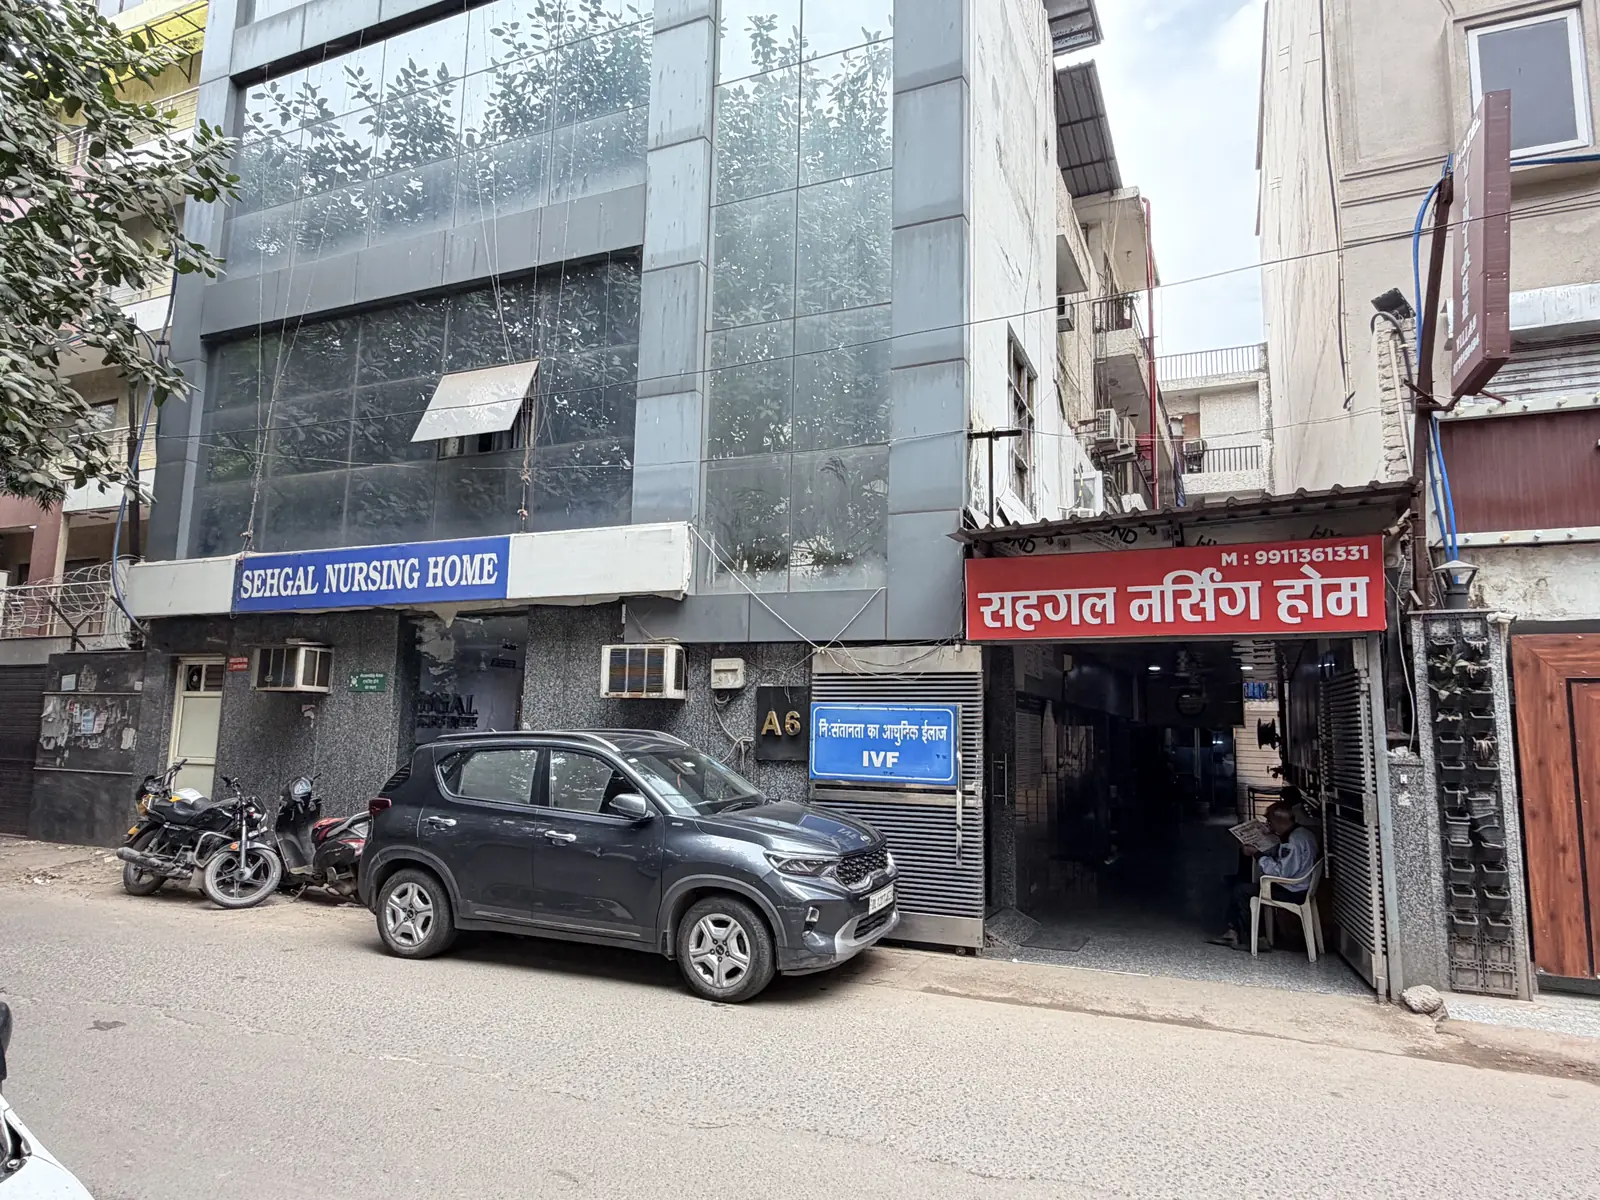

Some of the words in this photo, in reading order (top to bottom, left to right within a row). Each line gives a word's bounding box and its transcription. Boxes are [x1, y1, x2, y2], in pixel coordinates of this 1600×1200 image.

[1221, 552, 1238, 567] M
[1254, 545, 1369, 565] 9911361331
[240, 565, 319, 599] SEHGAL
[323, 558, 420, 594] NURSING
[426, 553, 499, 587] HOME
[977, 587, 1116, 631] सहगल
[1127, 567, 1262, 623] नर्सिंग
[1273, 563, 1370, 624] होम
[866, 723, 880, 739] का
[921, 719, 948, 744] ईलाज
[862, 750, 900, 768] IVF
